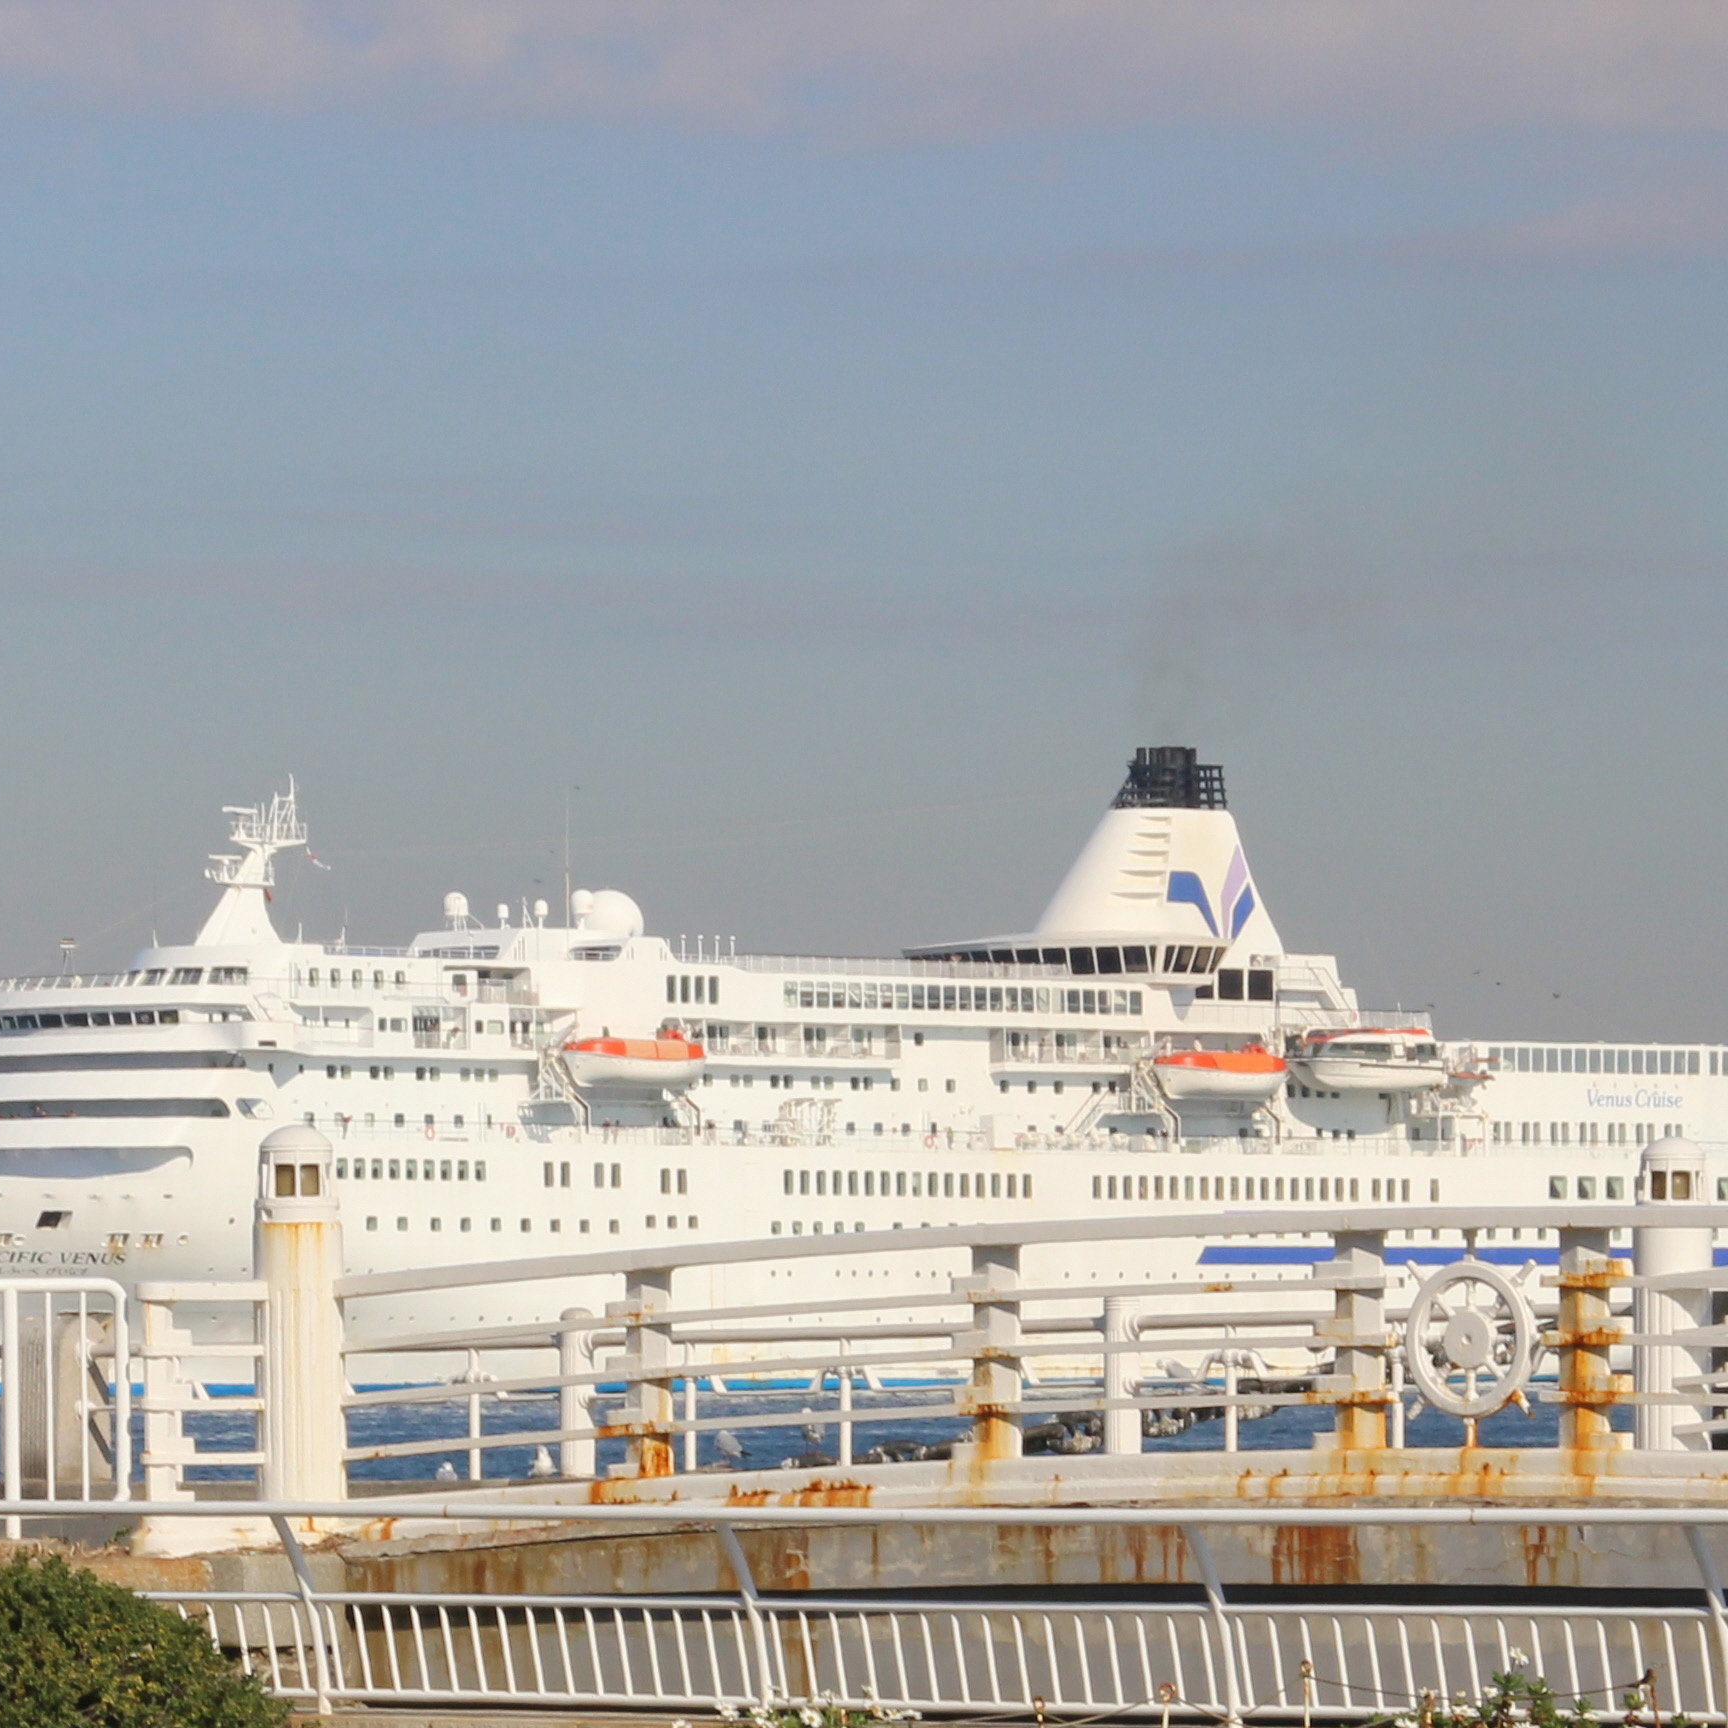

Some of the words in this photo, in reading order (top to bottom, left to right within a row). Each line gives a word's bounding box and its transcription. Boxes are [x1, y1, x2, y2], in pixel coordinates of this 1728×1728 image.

[1587, 1088, 1633, 1108] Venus
[1635, 1088, 1683, 1109] Cruise
[60, 1252, 127, 1266] VENUS
